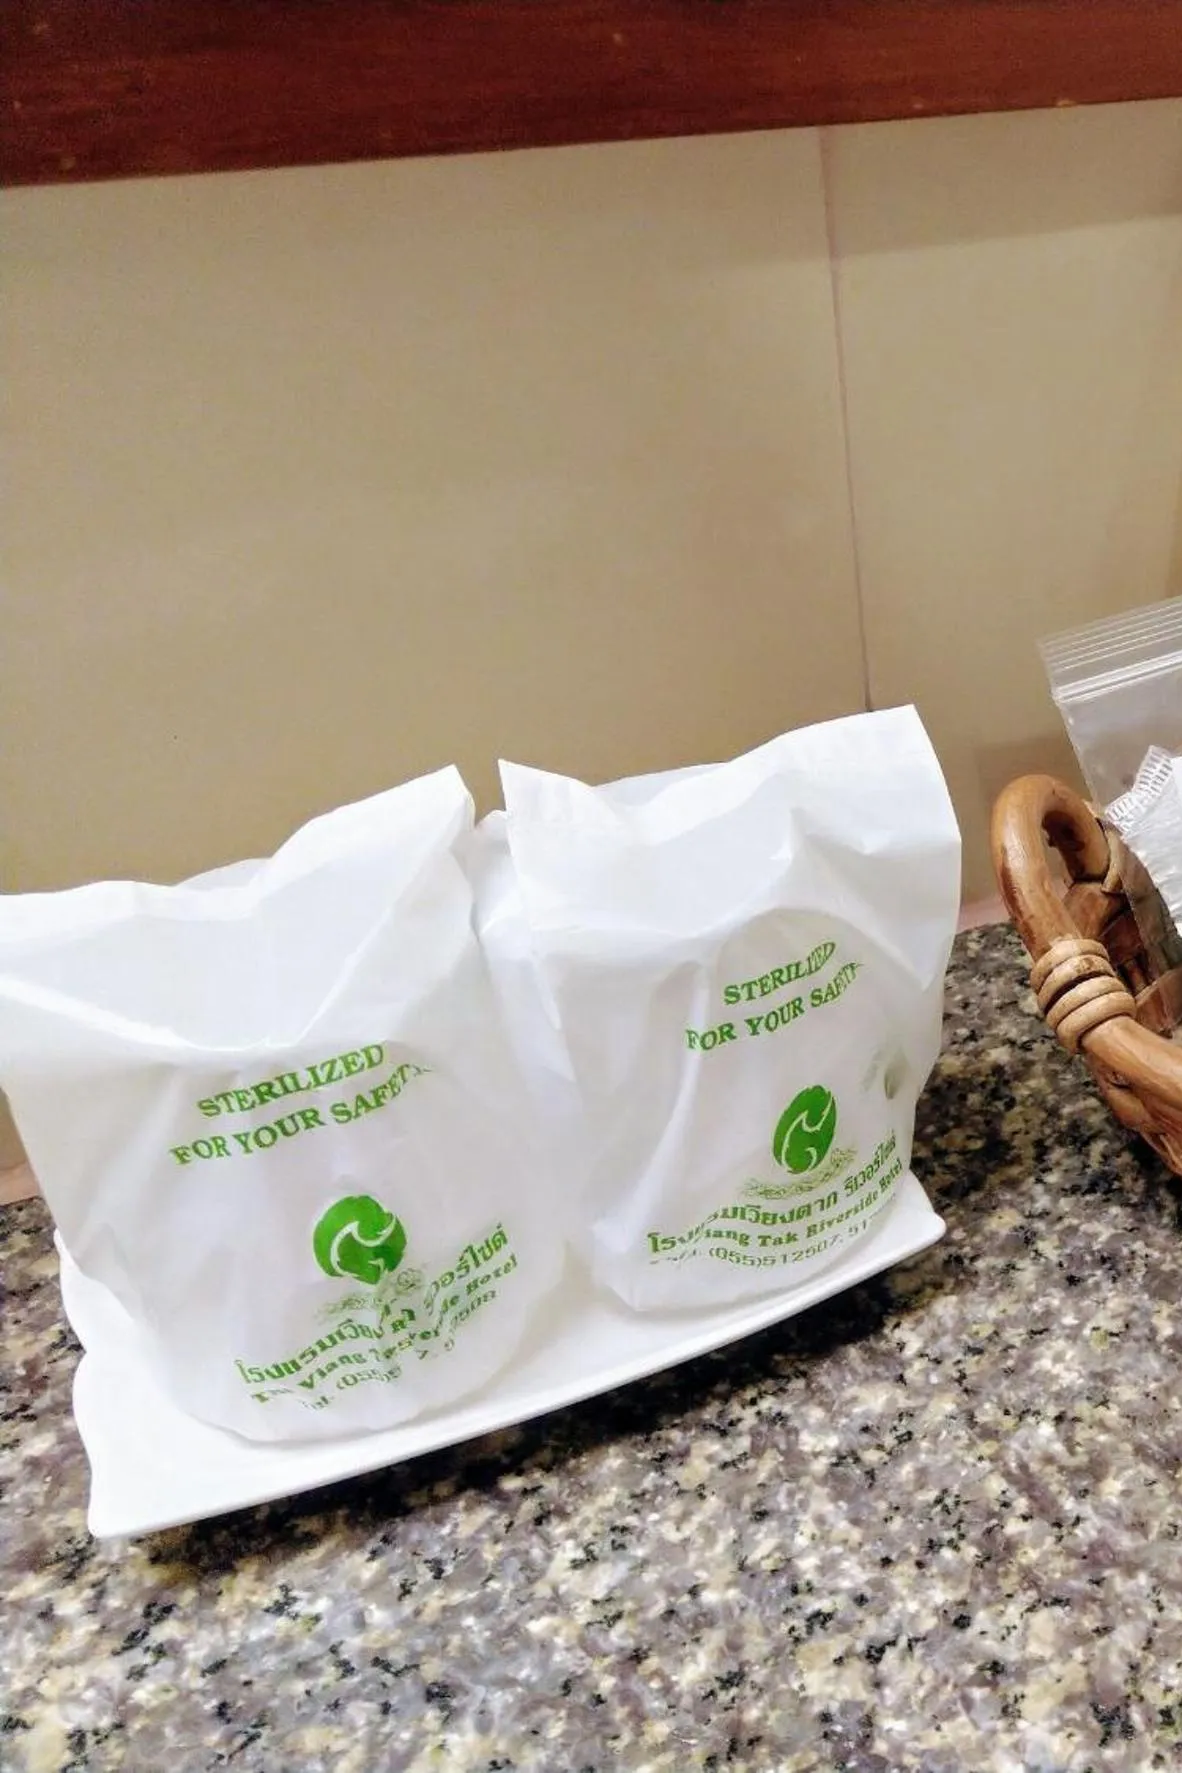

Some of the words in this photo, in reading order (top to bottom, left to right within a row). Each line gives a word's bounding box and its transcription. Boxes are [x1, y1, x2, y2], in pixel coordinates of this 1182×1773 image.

[685, 1021, 738, 1051] FOR
[744, 996, 805, 1036] YOUR
[197, 1044, 385, 1117] STERILIZED
[170, 1136, 232, 1165] FOR
[232, 1107, 328, 1154] YOUR
[757, 1231, 799, 1248] Tak
[806, 1189, 879, 1238] Riverside
